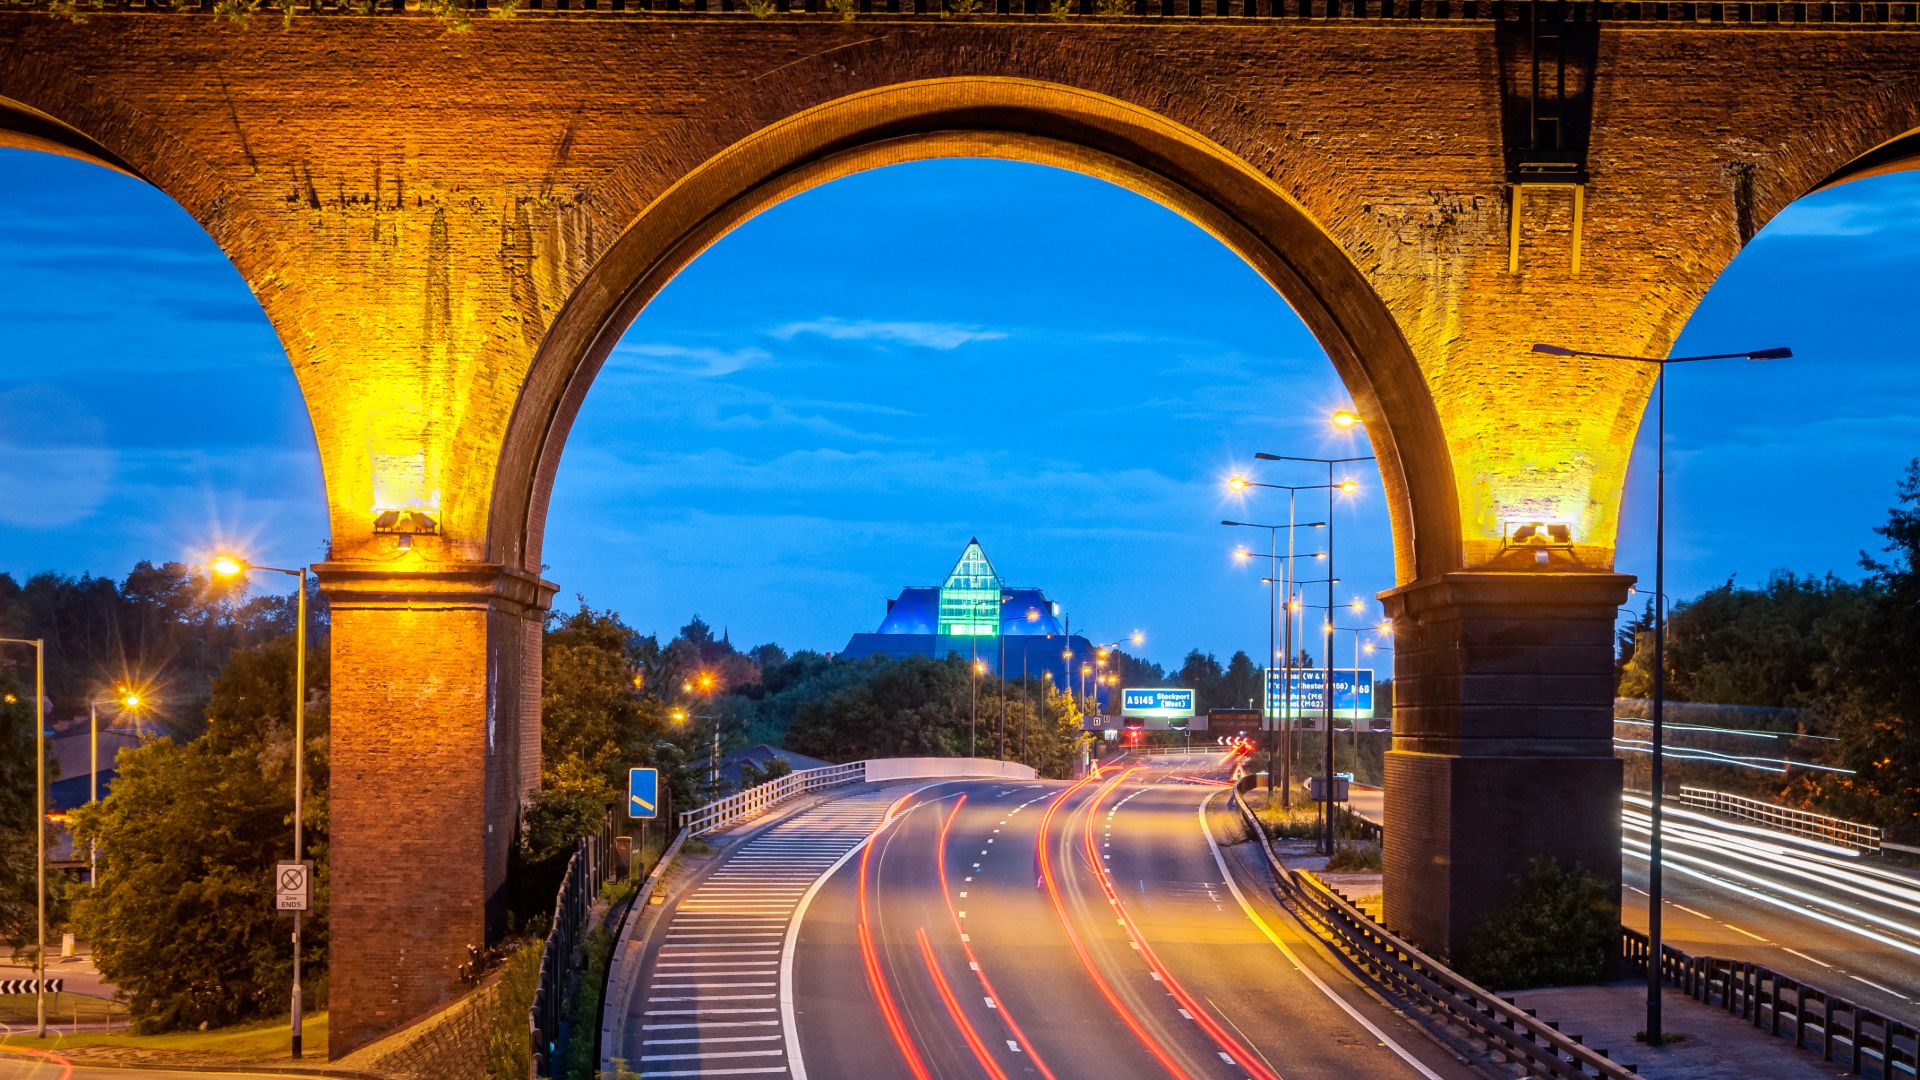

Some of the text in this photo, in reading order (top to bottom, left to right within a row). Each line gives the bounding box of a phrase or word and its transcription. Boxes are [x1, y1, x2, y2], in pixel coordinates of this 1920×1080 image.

[1326, 682, 1349, 690] (56)
[1351, 684, 1370, 694] M60
[1156, 692, 1190, 700] Stockport
[1160, 700, 1186, 708] (West)
[1300, 700, 1324, 708] (M62)
